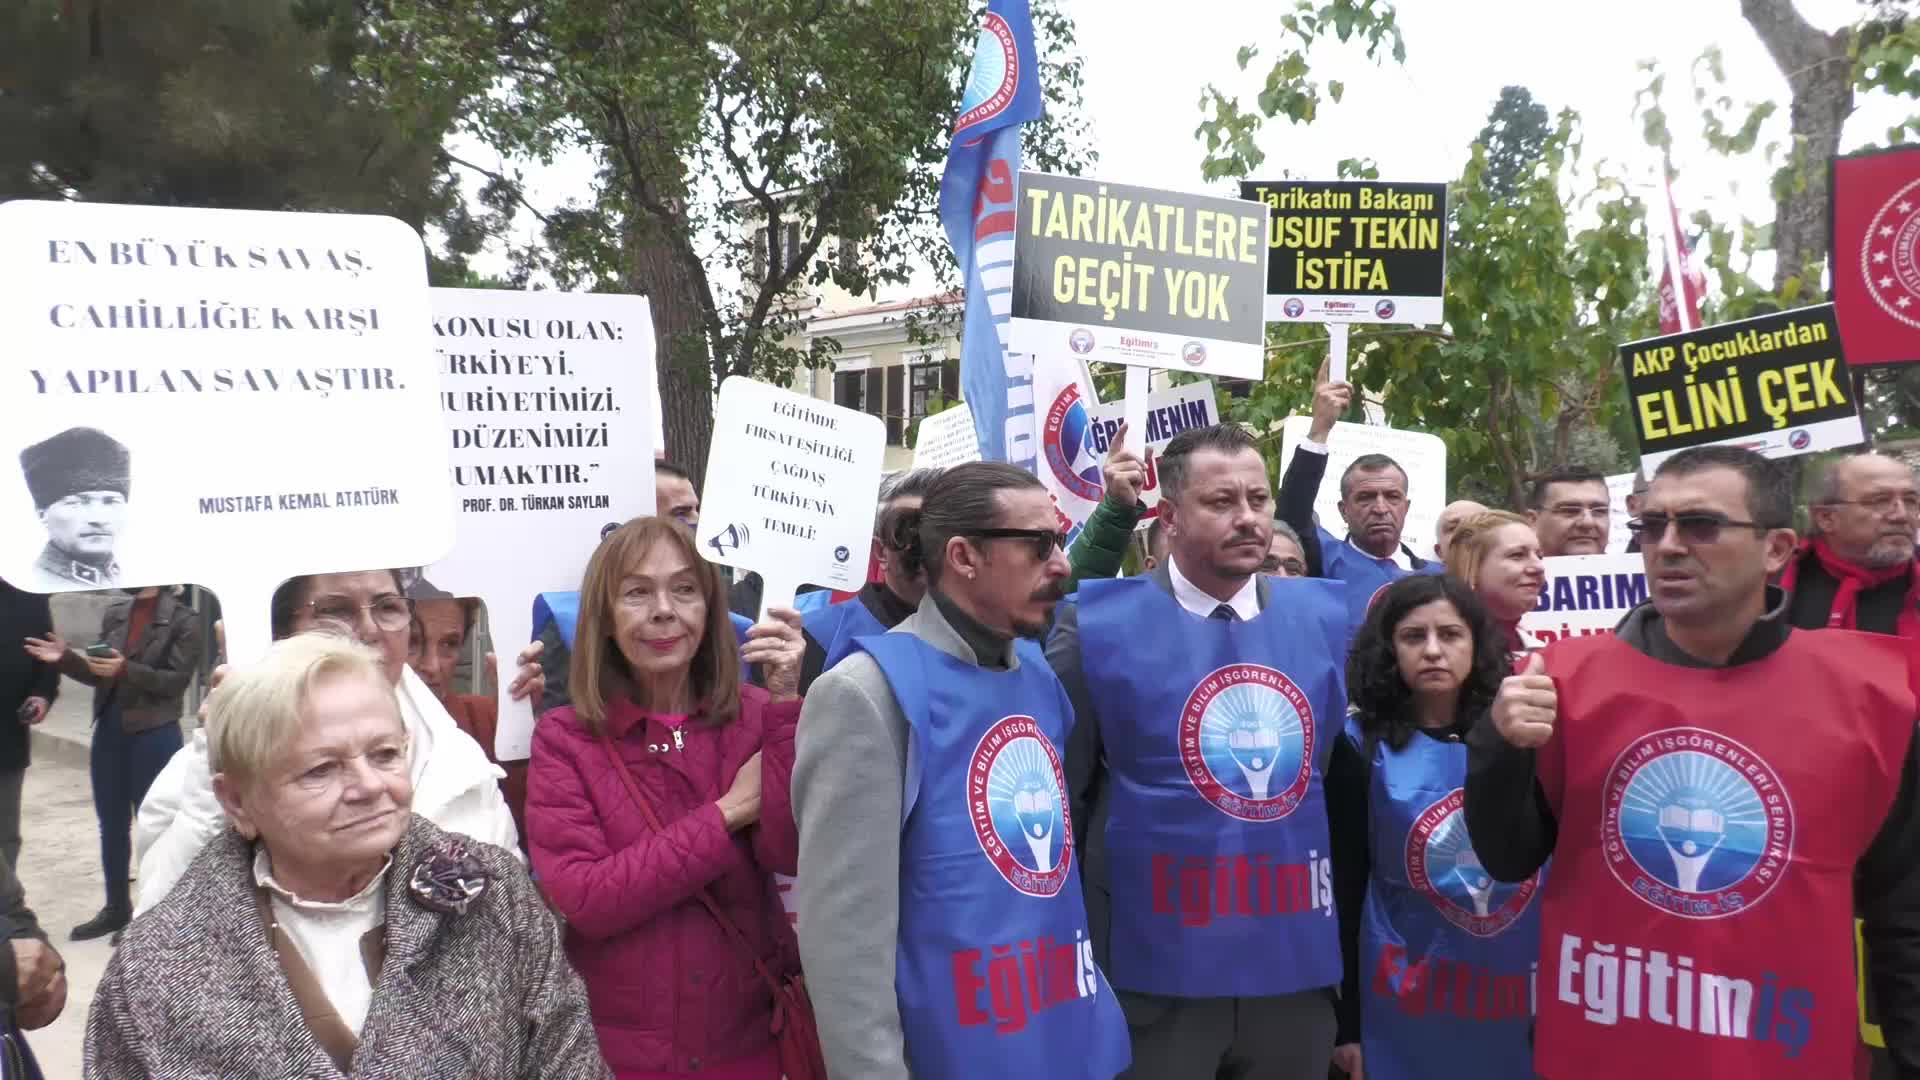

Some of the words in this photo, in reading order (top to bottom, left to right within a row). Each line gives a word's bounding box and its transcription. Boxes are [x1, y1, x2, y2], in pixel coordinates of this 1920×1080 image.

[1256, 187, 1352, 211] Tarikatın
[1359, 188, 1433, 211] Bakanı
[1027, 186, 1258, 265] TARİKATLERE
[1355, 210, 1439, 250] TEKİN
[48, 240, 97, 265] EN
[109, 236, 239, 268] BÜYÜK
[1053, 250, 1155, 321] GEÇİT
[1164, 267, 1230, 322] YOK
[1296, 252, 1389, 291] İSTİFA
[49, 298, 262, 330] CAHİLLİĞE
[271, 307, 380, 336] KARŞI
[1632, 347, 1676, 379] AKP
[1683, 321, 1829, 375] Çocuklardan
[29, 368, 203, 395] YAPILAN
[213, 366, 406, 399] SAVAŞTIR.
[441, 386, 621, 414] URİYETİMİZİ,
[1636, 366, 1747, 441] ELİNİ
[1758, 357, 1847, 430] ÇEK
[773, 401, 838, 430] EĞİTİMDE
[452, 422, 608, 448] DÜZENİMİZİ
[746, 423, 793, 446] FIRSAT
[450, 464, 600, 486] UMAKTIR.”
[771, 460, 826, 487] ÇAĞDAŞ
[199, 494, 273, 514] MUSTAFA
[279, 491, 331, 511] KEMAL
[335, 486, 400, 508] ATATÜRK
[462, 498, 495, 512] PROF.
[499, 497, 518, 511] DR.
[522, 494, 565, 511] TÜRKAN
[568, 495, 609, 509] SAYLAN
[1191, 680, 1218, 712] BİLİM
[1221, 669, 1301, 706] İŞGÖRENLERİ
[1186, 715, 1197, 732] VE
[974, 776, 984, 795] VE
[979, 733, 1002, 771] BİLİM
[1613, 782, 1624, 801] VE
[1620, 743, 1654, 780] BİLİM
[1657, 734, 1774, 790] İŞGÖRENLERİ
[1755, 794, 1786, 885] SENDİKASI
[1558, 933, 1814, 1059] Eğitimiş
